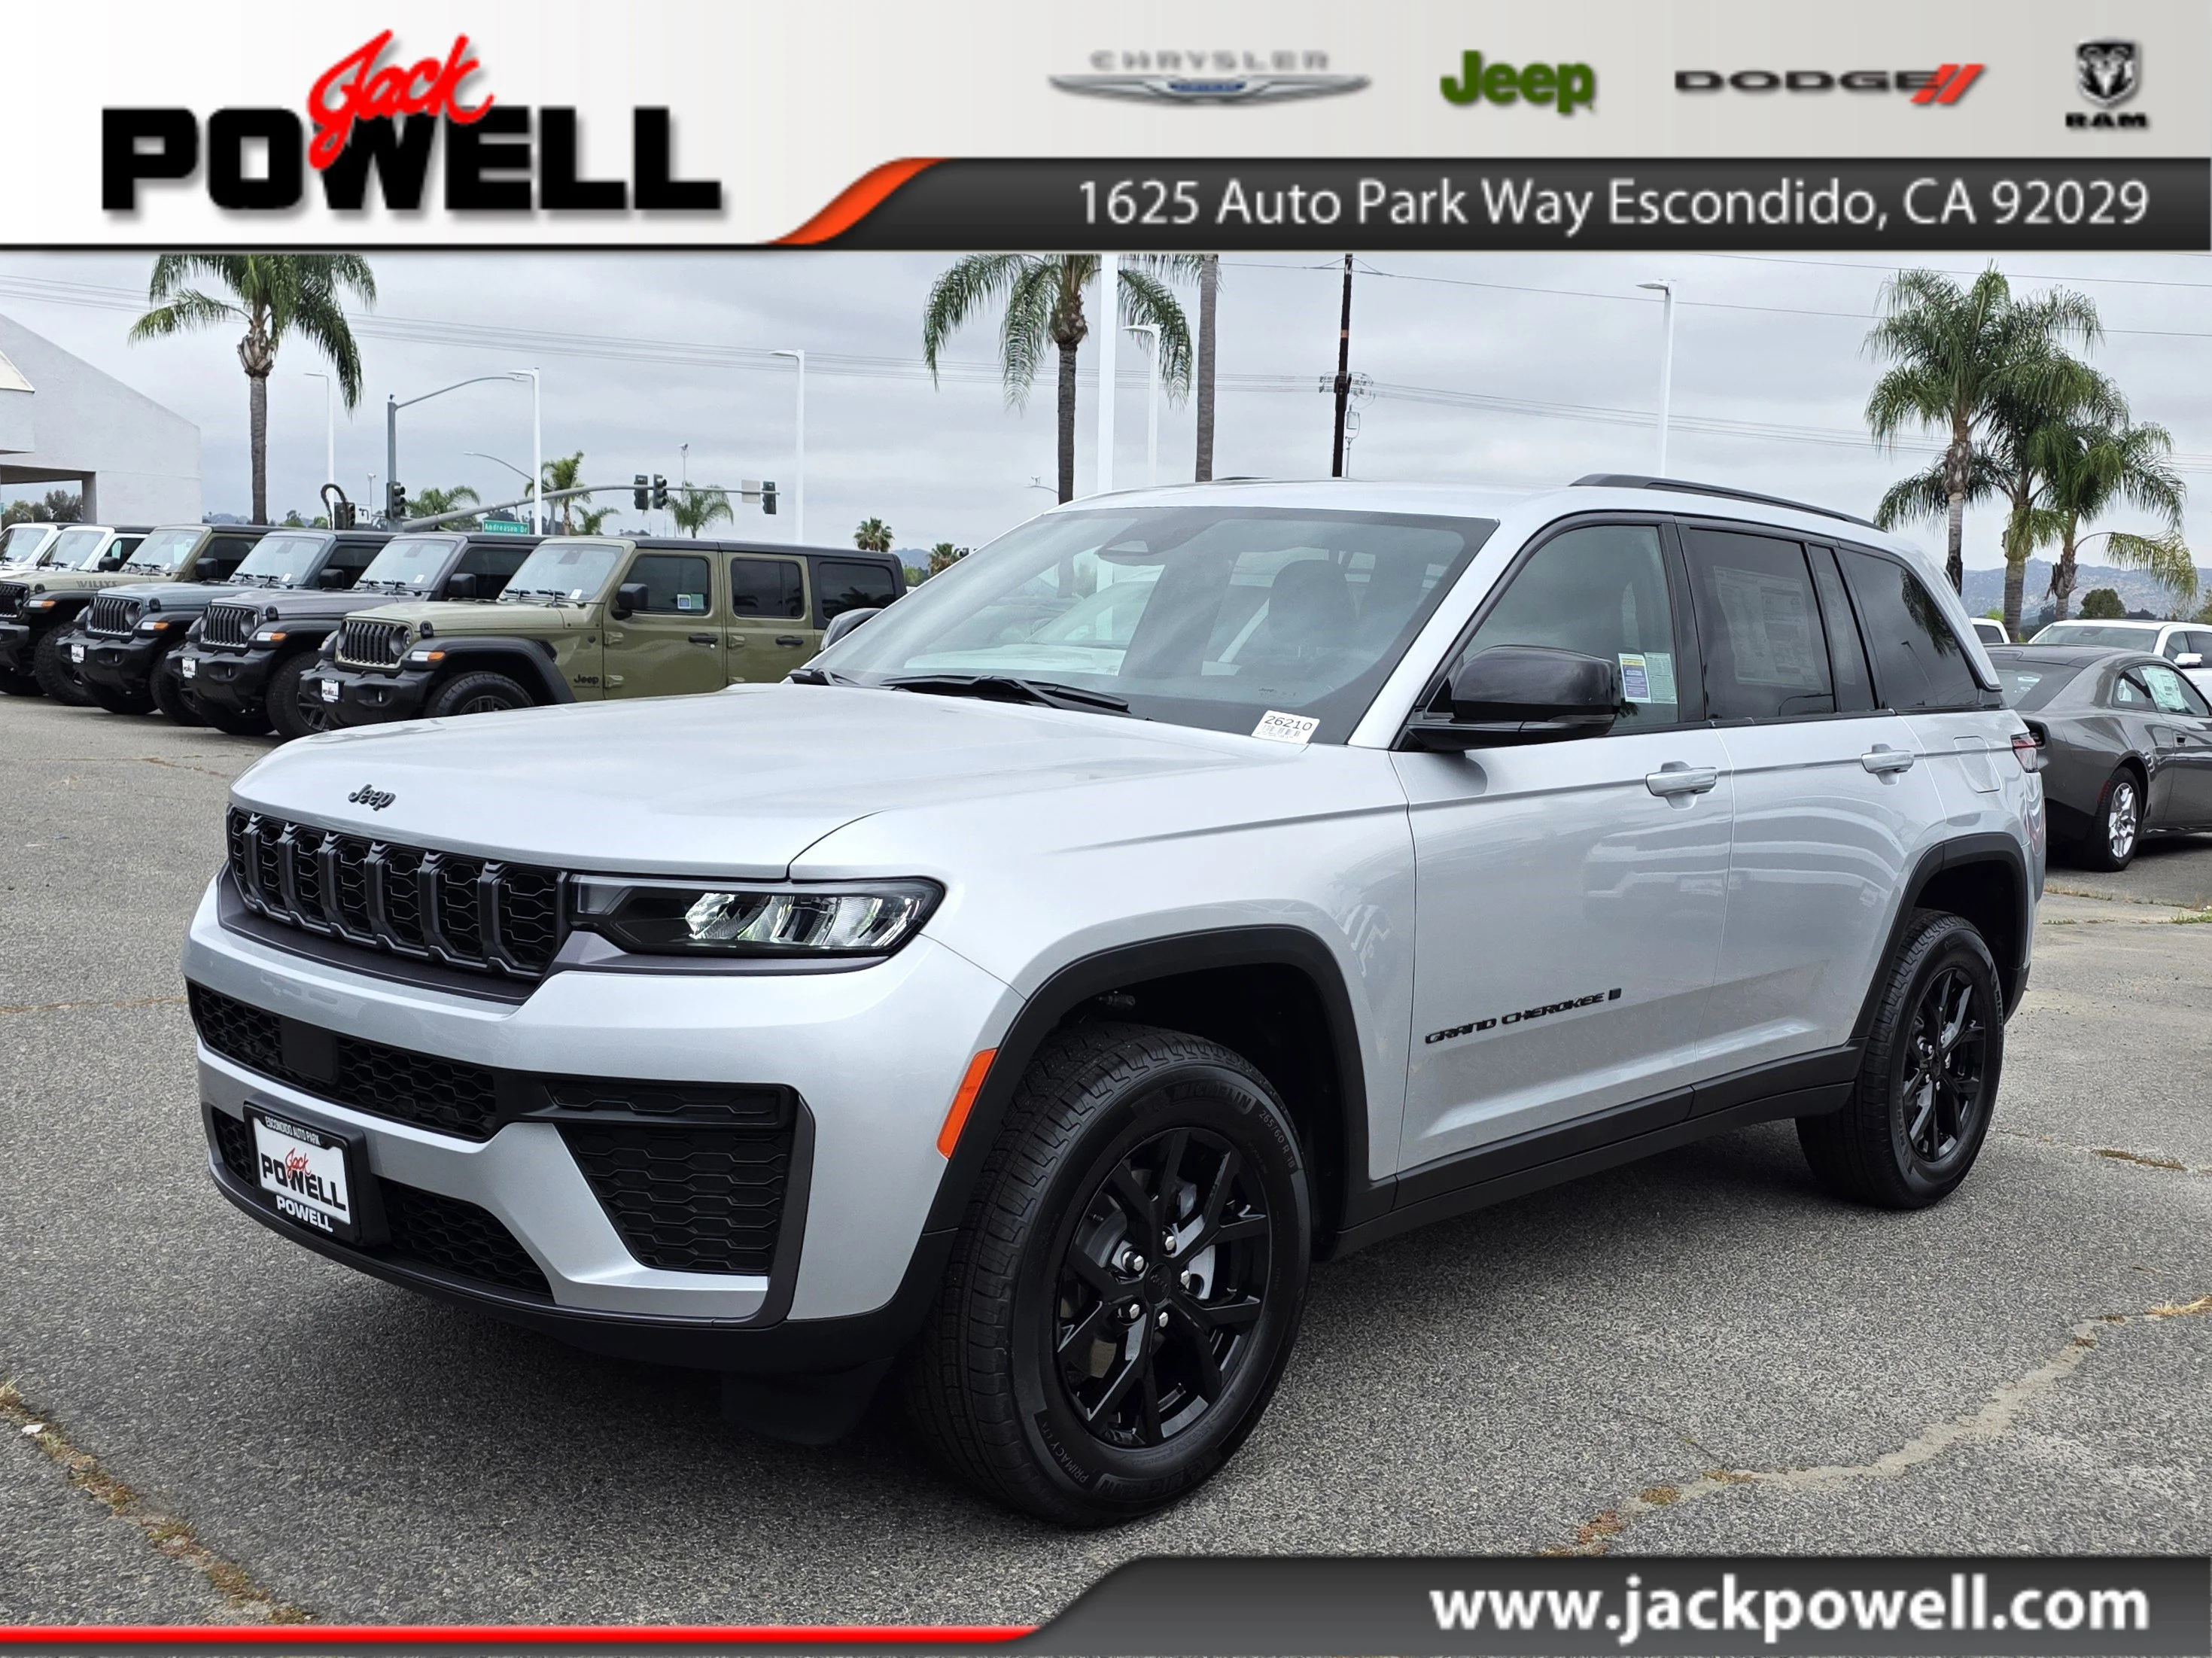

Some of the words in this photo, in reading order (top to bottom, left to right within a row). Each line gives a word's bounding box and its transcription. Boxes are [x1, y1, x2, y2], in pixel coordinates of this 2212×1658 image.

[574, 674, 599, 685] Jeep
[1264, 715, 1313, 731] 26210
[348, 783, 397, 811] Jeep
[1425, 1018, 1497, 1044] GRAND
[1501, 993, 1605, 1024] CHEROKEE
[1173, 1082, 1252, 1112] MICHELIN
[1258, 1110, 1285, 1144] 265/60
[1282, 1144, 1290, 1155] R
[292, 1127, 306, 1141] AUTO
[306, 1131, 321, 1146] PARK
[285, 1147, 311, 1180] Jack
[261, 1152, 347, 1212] POWELL
[276, 1195, 333, 1233] POWELL
[1051, 1440, 1090, 1484] PRIMACY
